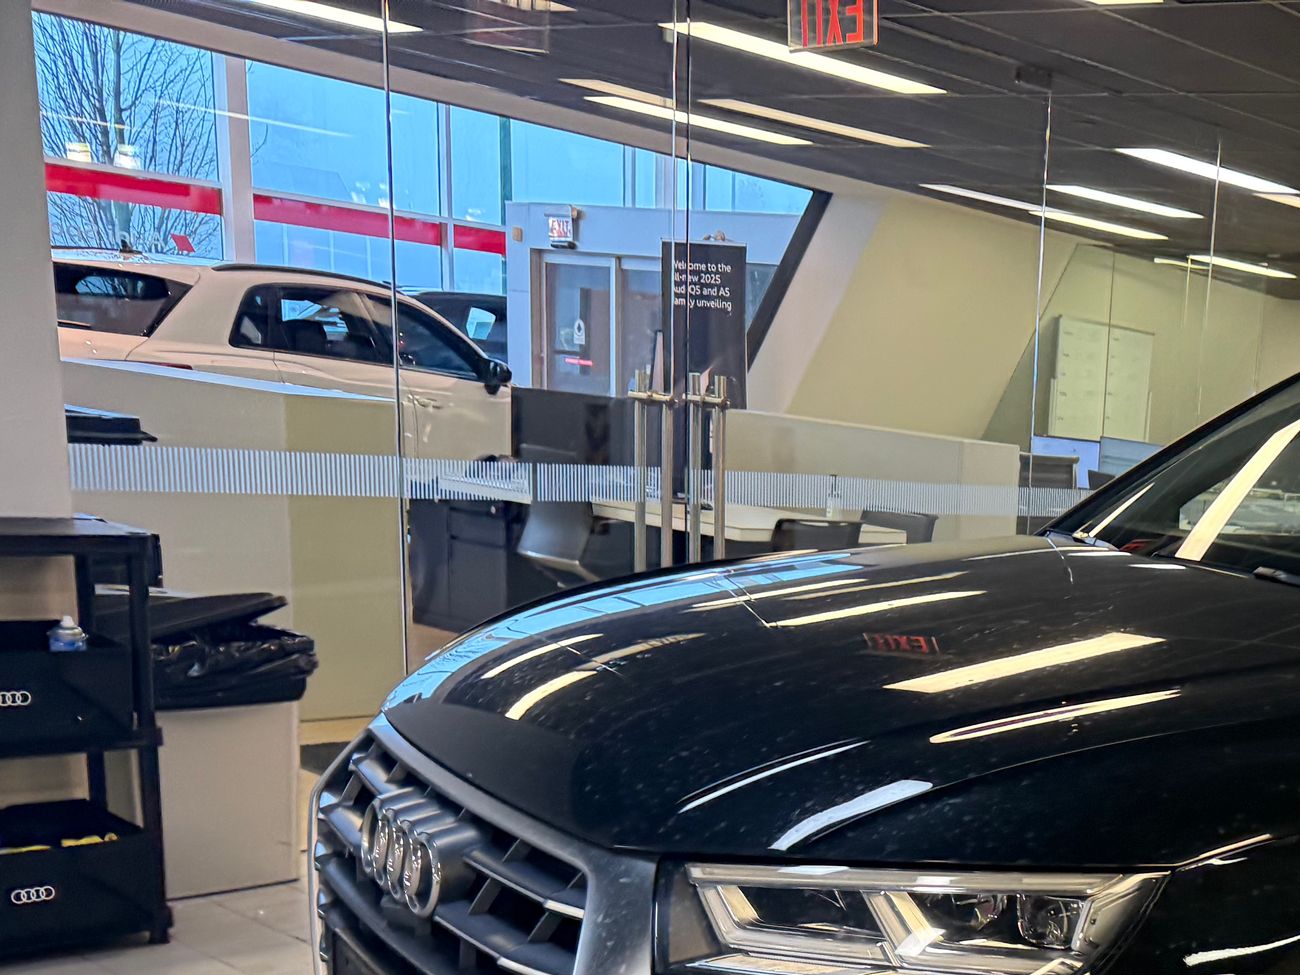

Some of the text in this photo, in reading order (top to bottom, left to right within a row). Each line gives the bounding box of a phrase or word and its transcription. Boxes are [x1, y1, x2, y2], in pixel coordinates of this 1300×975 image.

[708, 263, 717, 272] to
[718, 263, 732, 273] the
[700, 273, 721, 284] 2025
[702, 286, 717, 296] and
[696, 298, 732, 312] unveiling
